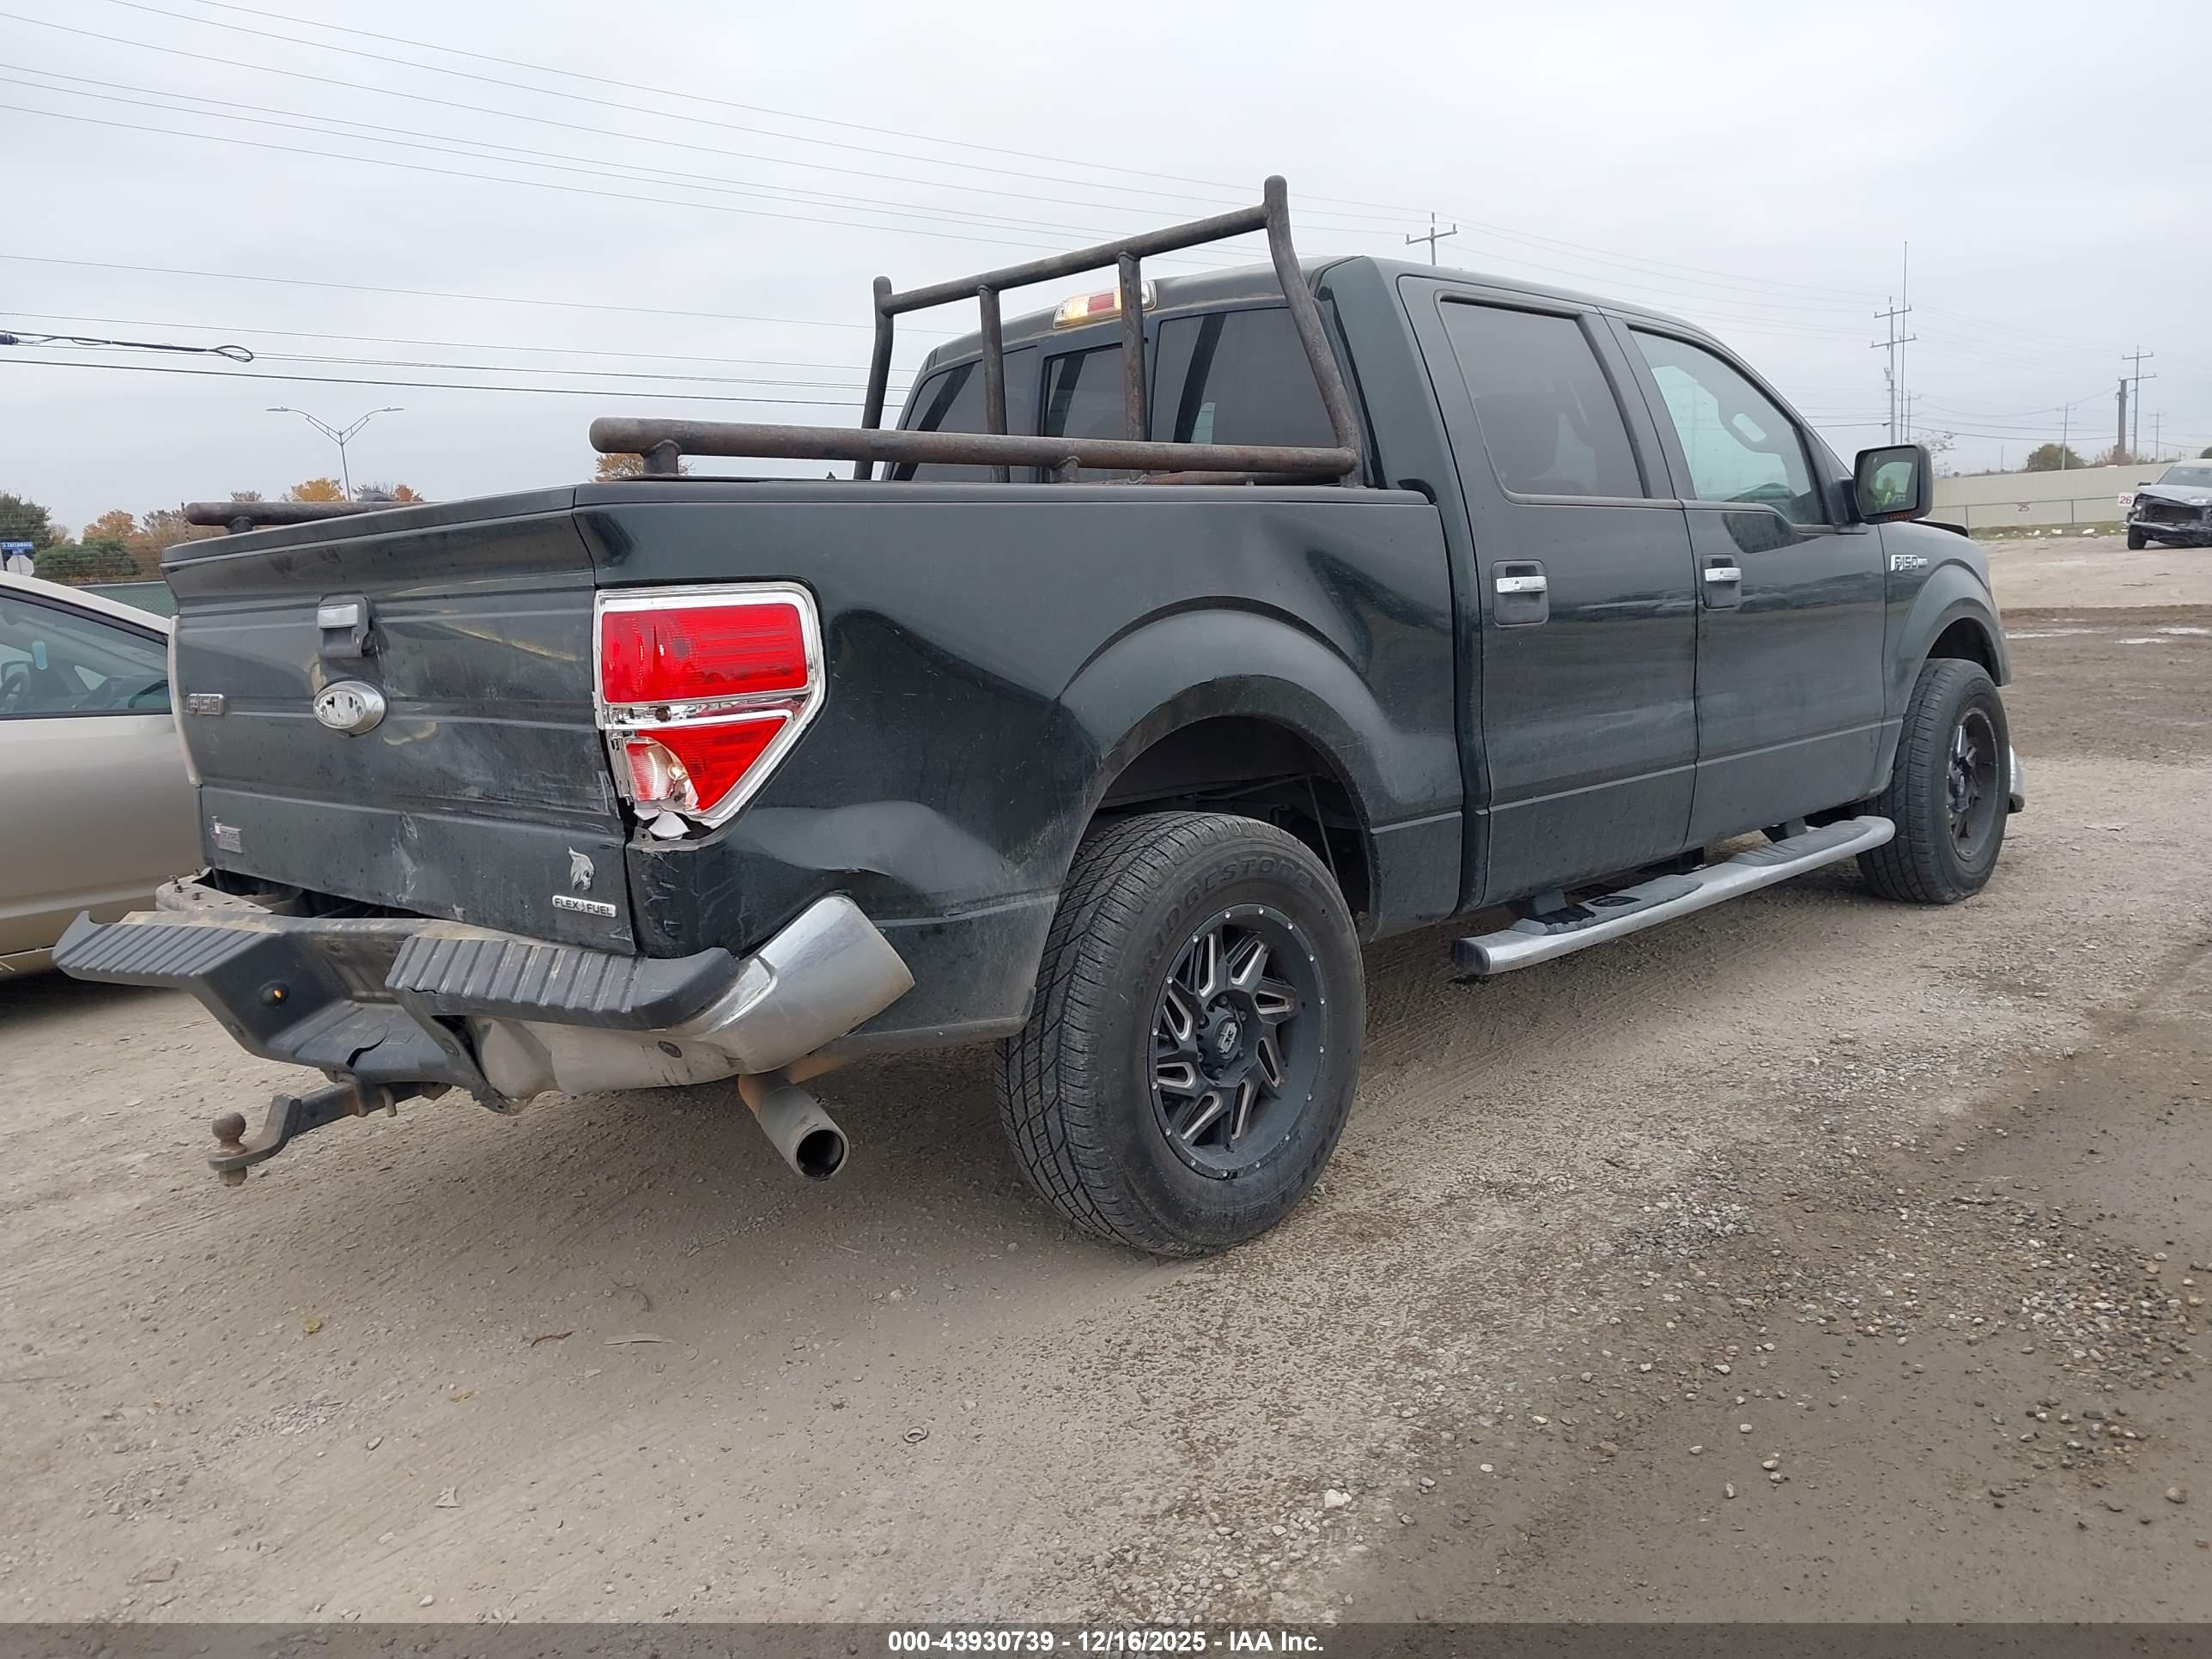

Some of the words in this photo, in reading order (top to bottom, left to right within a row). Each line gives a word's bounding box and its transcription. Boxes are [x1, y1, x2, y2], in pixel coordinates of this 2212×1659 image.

[2119, 495, 2132, 505] 26
[2018, 502, 2030, 512] 25
[555, 897, 579, 910] FLEX
[586, 903, 613, 916] FUEL
